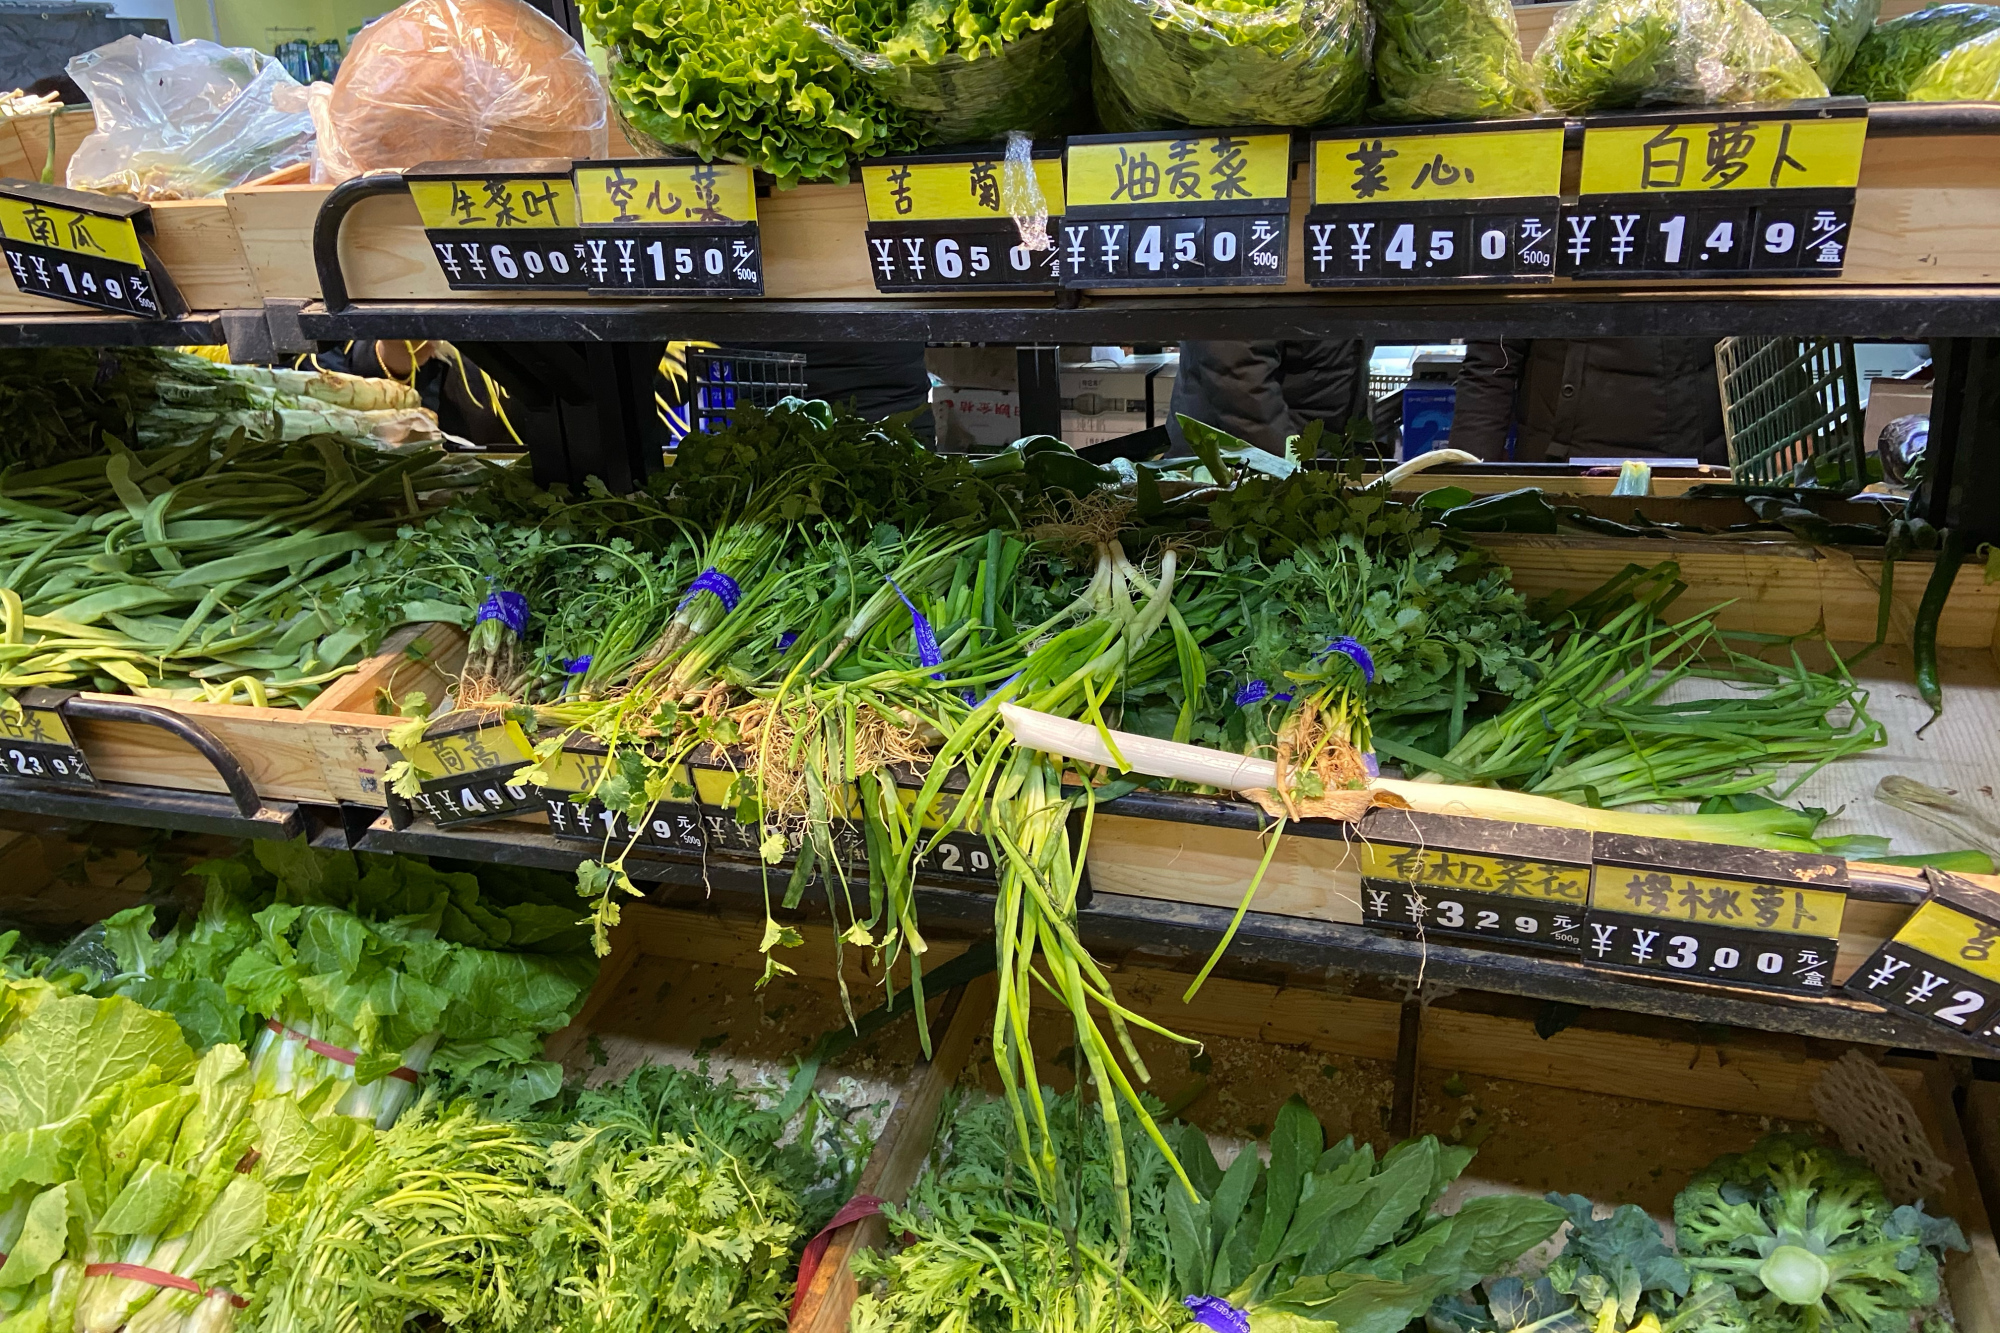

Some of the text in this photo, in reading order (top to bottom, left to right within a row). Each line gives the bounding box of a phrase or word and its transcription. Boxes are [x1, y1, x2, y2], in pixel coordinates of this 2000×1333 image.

[1111, 137, 1253, 201] 油麦菜
[1346, 140, 1475, 198] 菜心
[1641, 121, 1807, 189] 白萝卜
[450, 178, 560, 227] 生菜叶
[606, 165, 736, 223] 空心菜
[22, 203, 107, 254] 南瓜
[1386, 847, 1587, 900] 有机菜花
[1625, 873, 1818, 930] 樱桃萝卜
